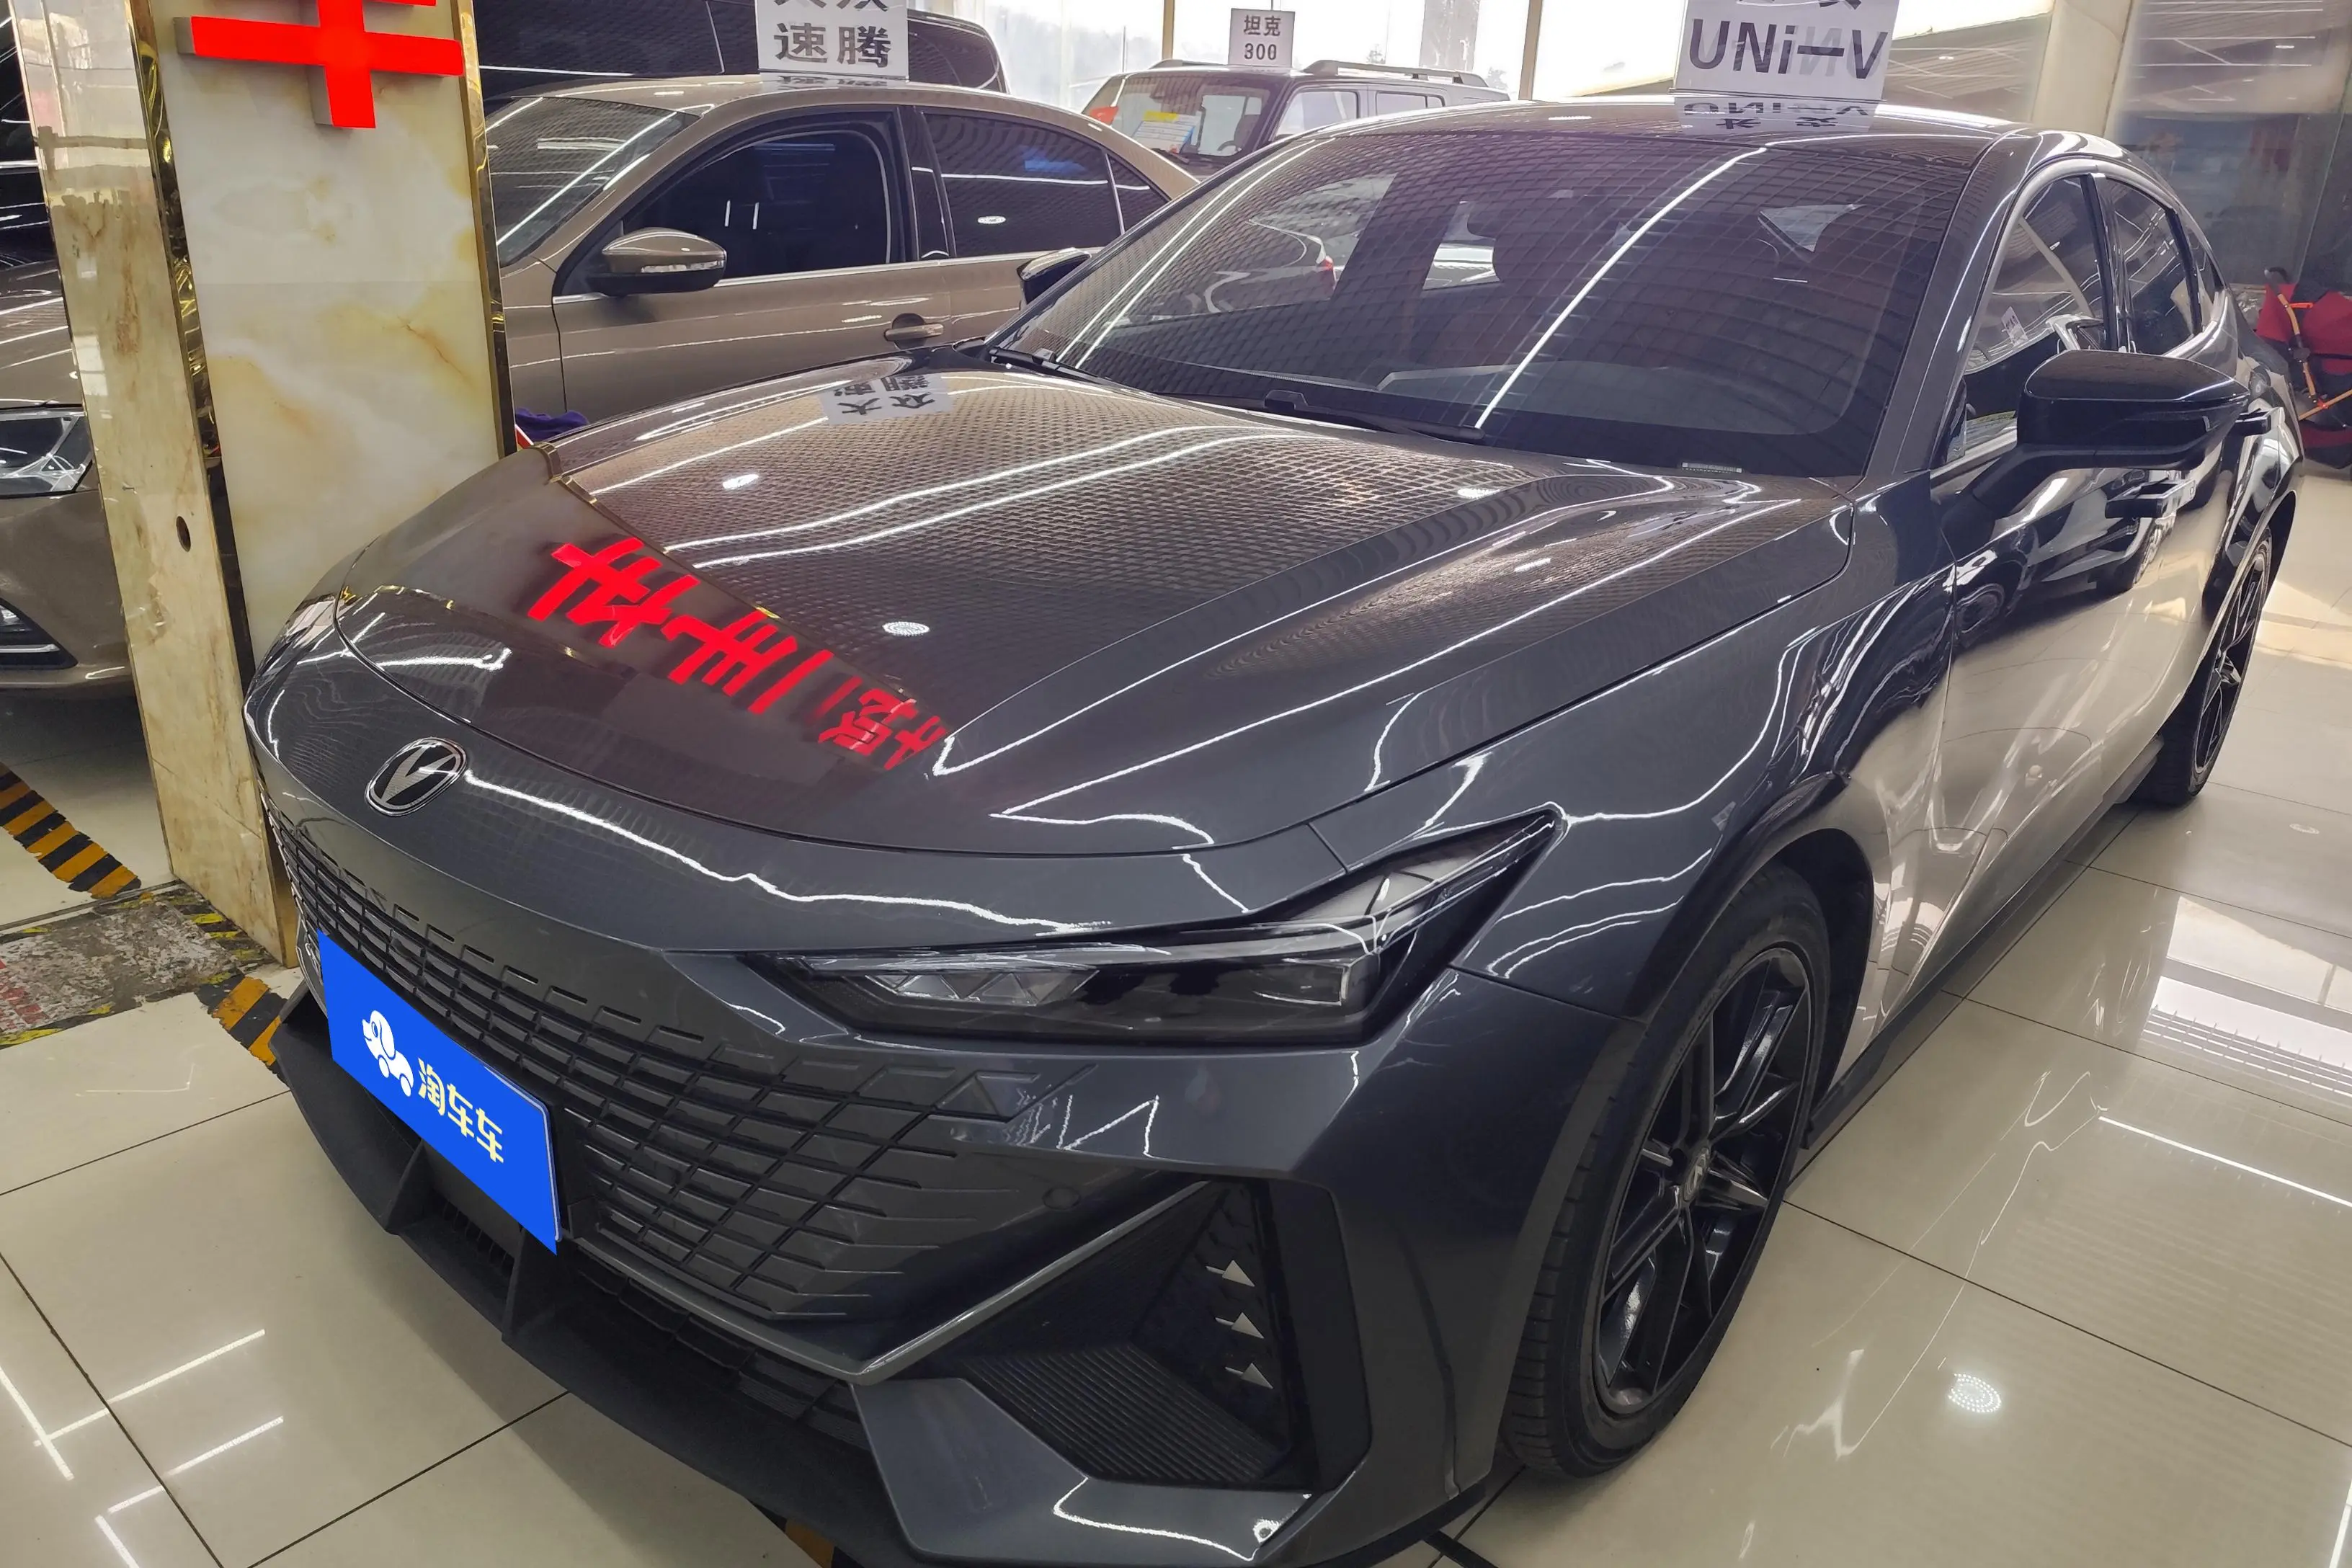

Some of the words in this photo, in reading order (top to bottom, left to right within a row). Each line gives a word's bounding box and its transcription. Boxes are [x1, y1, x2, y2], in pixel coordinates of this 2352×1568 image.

[1244, 14, 1281, 36] 坦克
[774, 23, 891, 68] 速腾
[1244, 43, 1277, 60] 300
